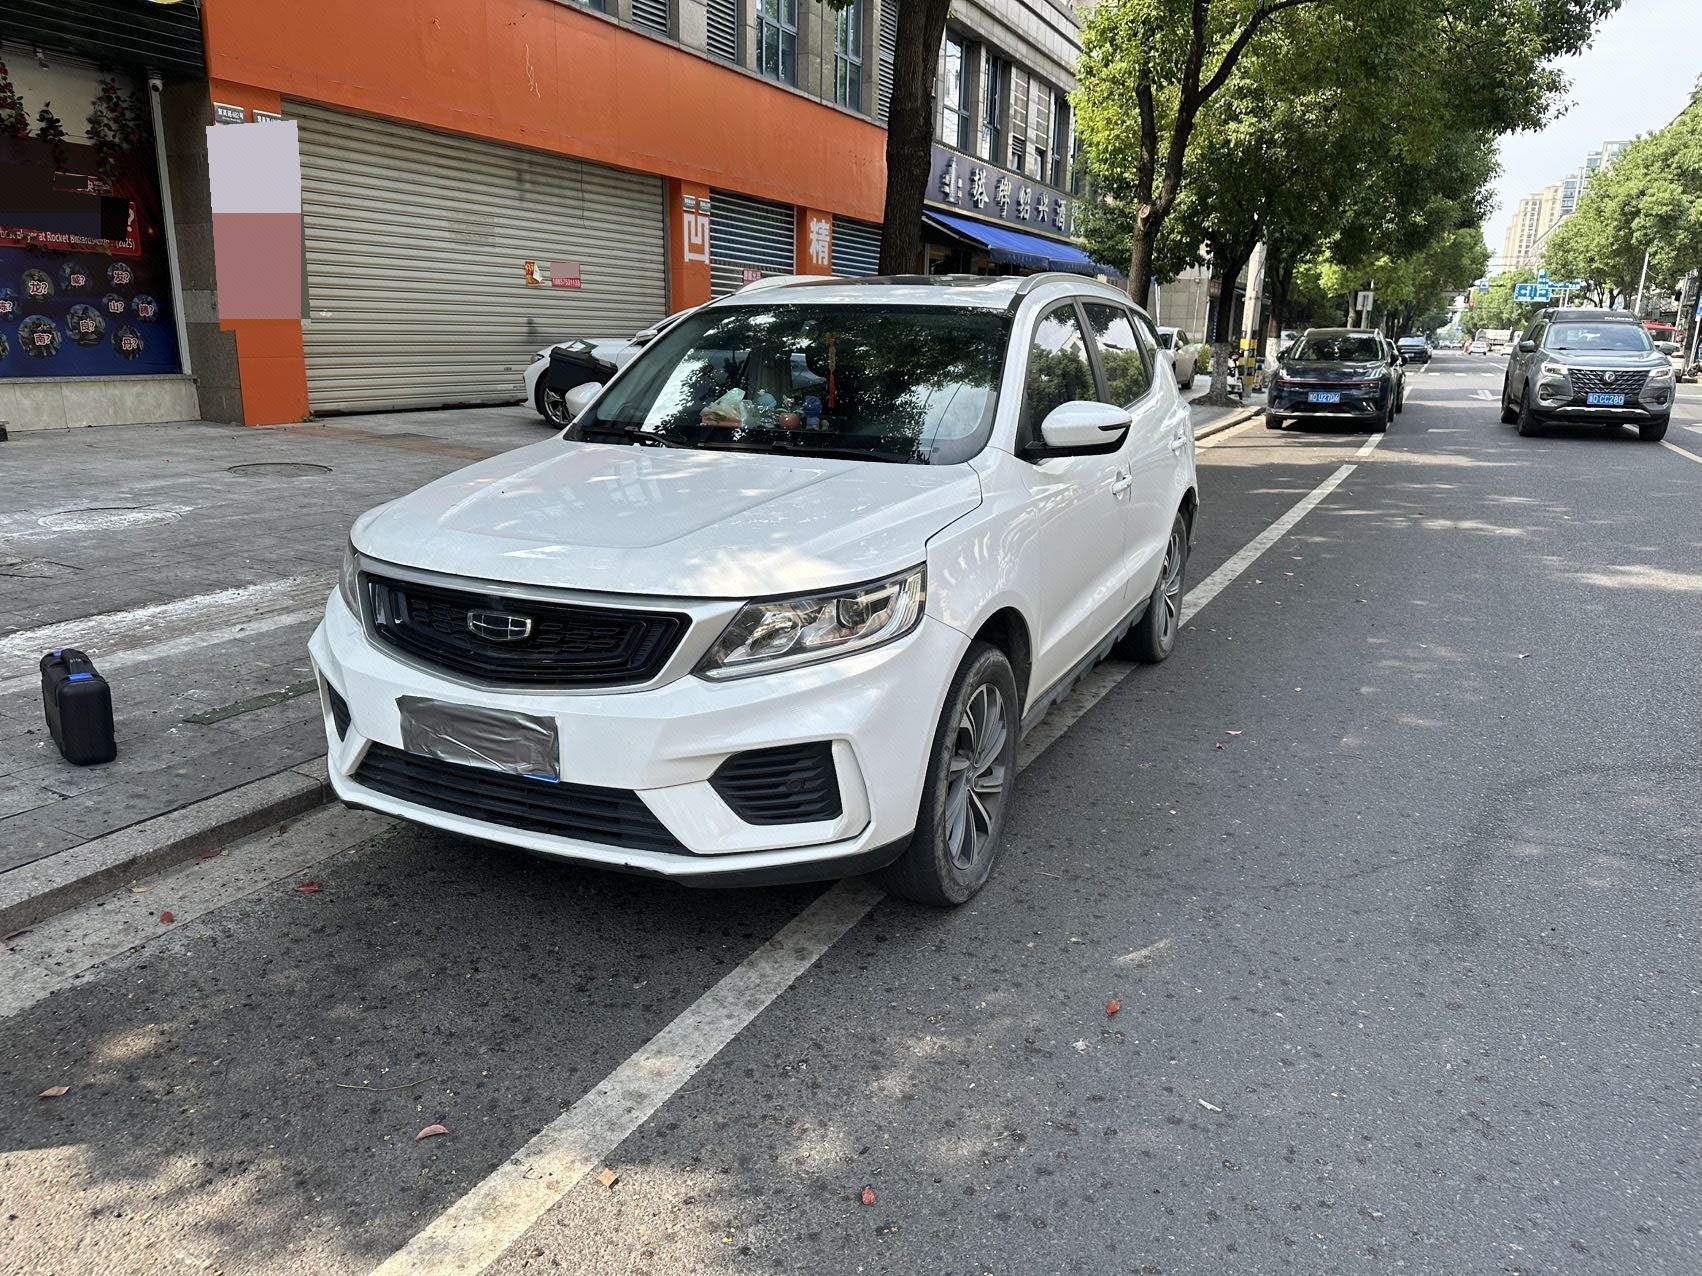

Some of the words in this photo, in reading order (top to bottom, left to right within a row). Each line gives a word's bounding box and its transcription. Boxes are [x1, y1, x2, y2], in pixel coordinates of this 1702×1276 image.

[39, 232, 46, 241] at
[47, 231, 69, 244] Rocket
[810, 217, 830, 265] 精
[114, 271, 130, 284] 发?
[29, 281, 48, 295] 龙?
[109, 301, 124, 313] 山?
[80, 319, 95, 332] 良?
[34, 333, 51, 345] 南?
[122, 337, 138, 350] 丹?
